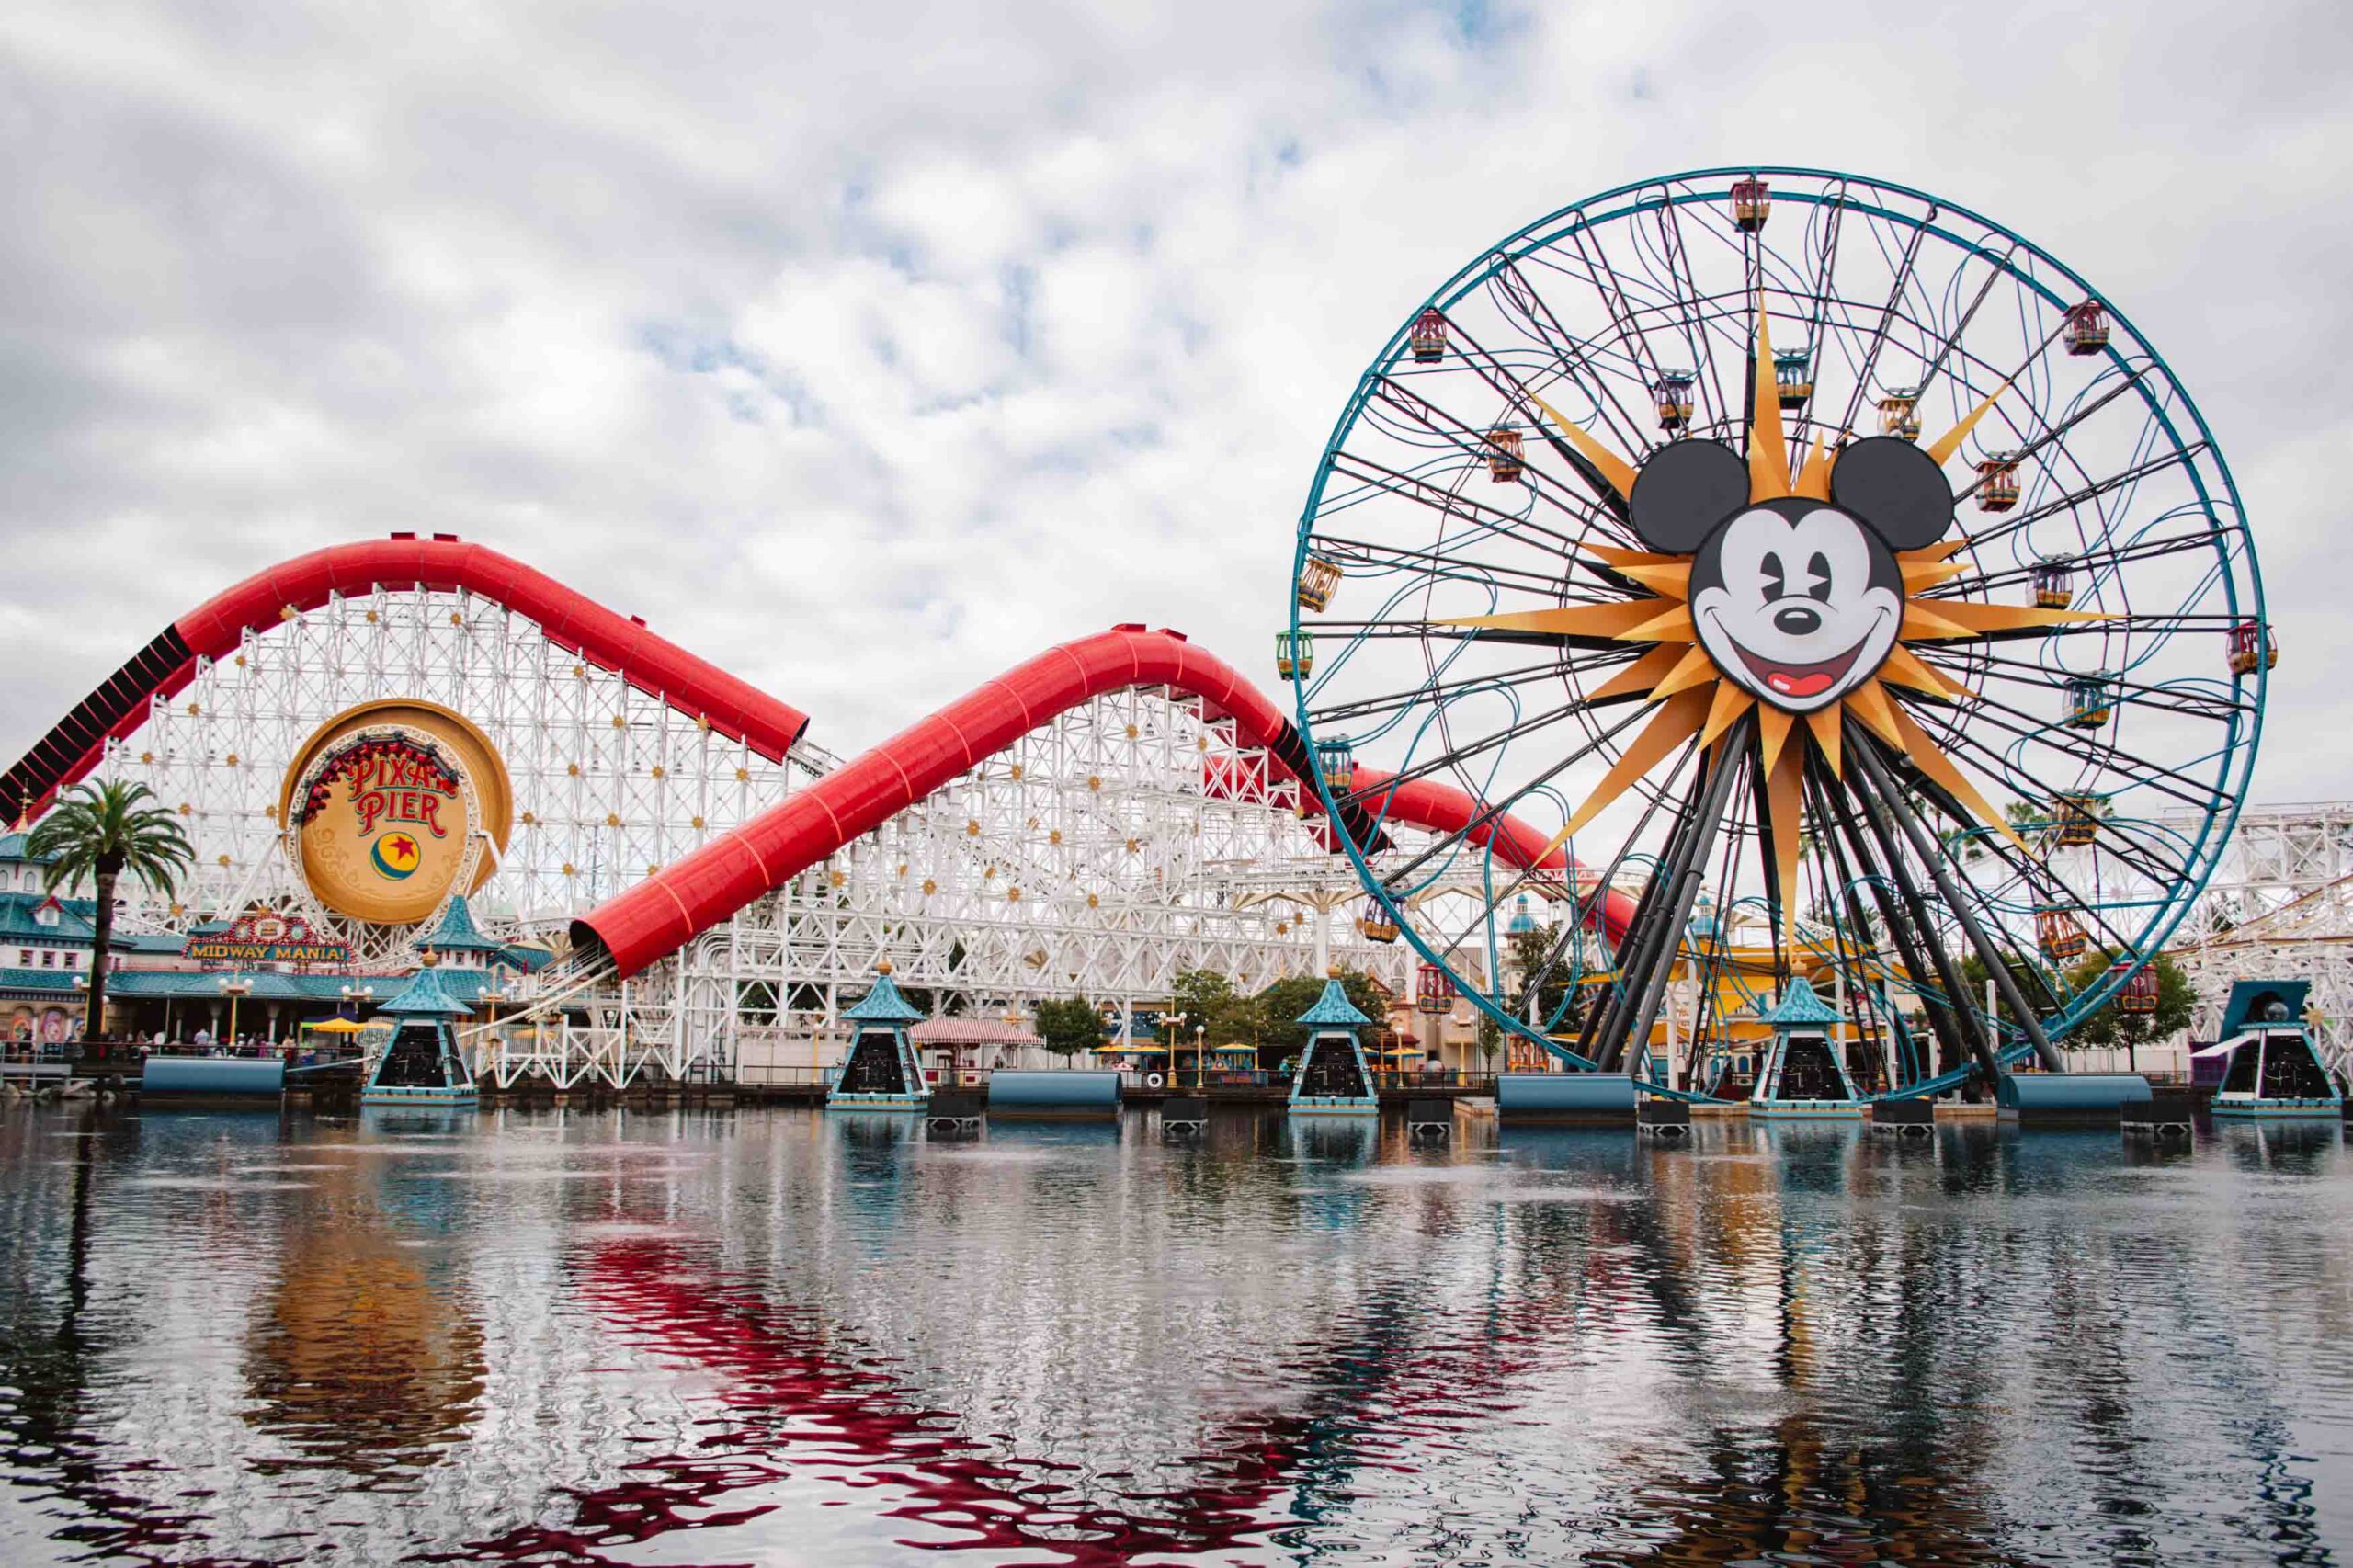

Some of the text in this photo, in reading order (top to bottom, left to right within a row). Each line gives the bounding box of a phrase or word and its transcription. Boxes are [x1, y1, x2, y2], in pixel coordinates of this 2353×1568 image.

[356, 790, 447, 837] PIER
[191, 945, 346, 960] MIDWAY MANIA!
